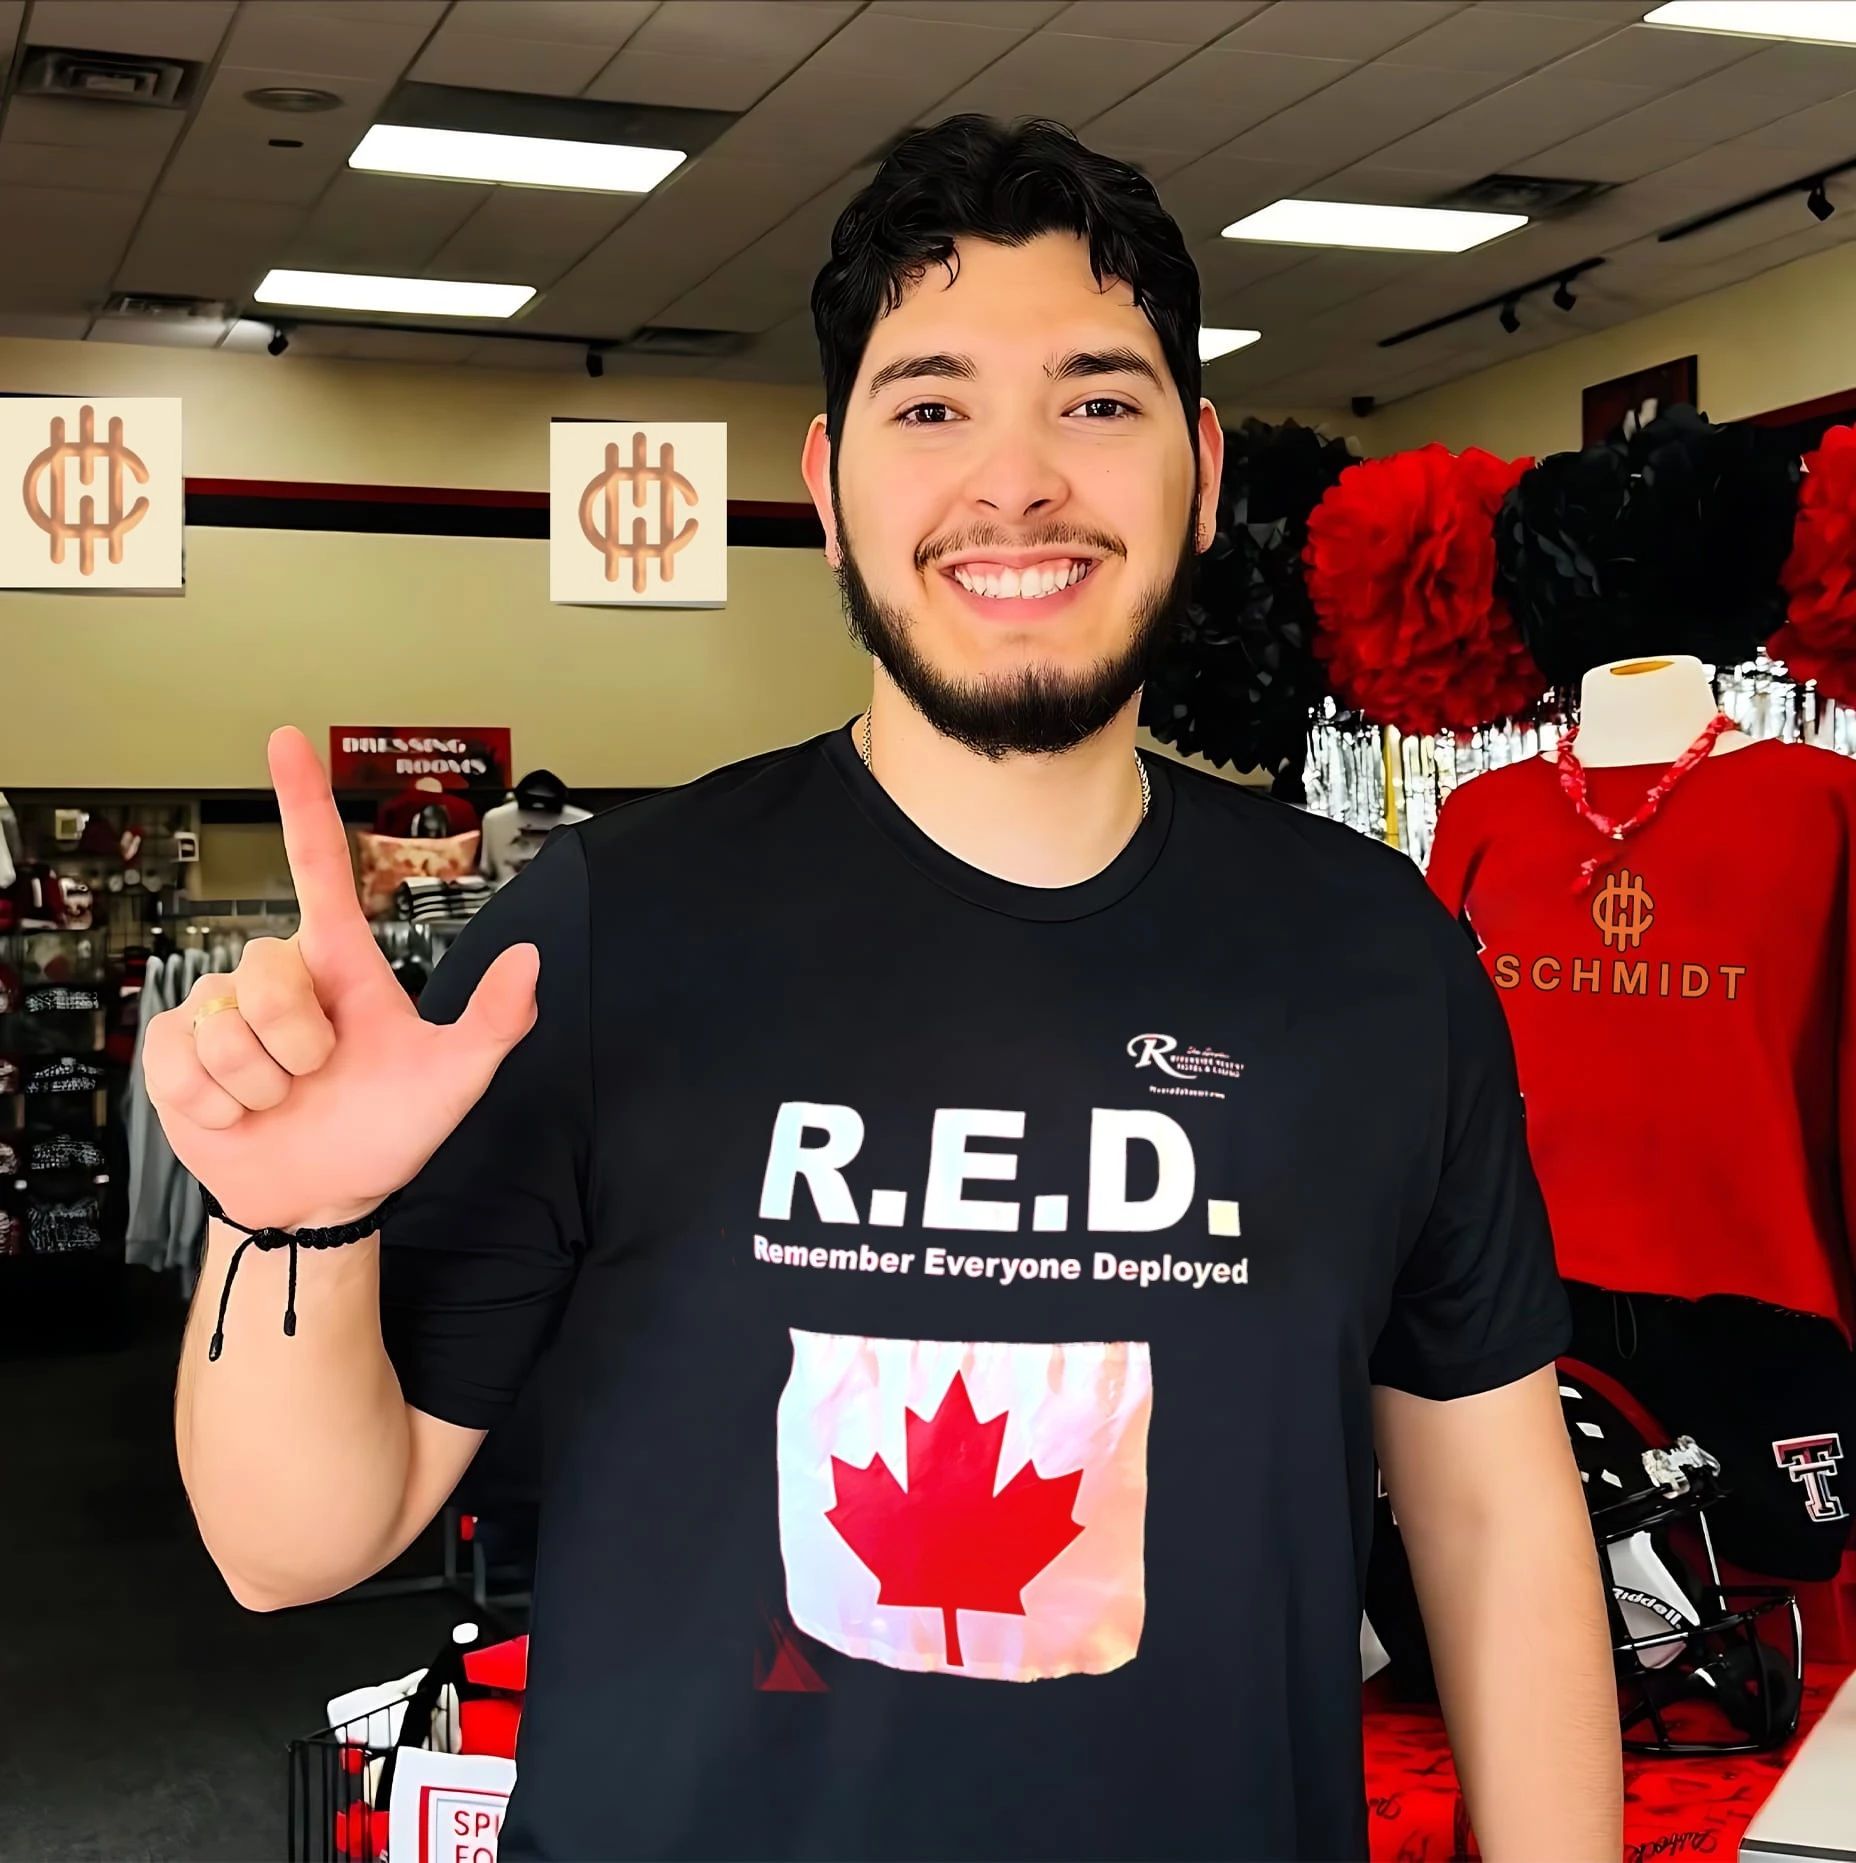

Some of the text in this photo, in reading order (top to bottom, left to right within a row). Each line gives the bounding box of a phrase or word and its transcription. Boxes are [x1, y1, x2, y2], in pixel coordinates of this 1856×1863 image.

[1493, 954, 1747, 1001] SCHMIDT
[1126, 1033, 1198, 1079] R
[759, 1101, 1241, 1237] R.E.D.
[753, 1234, 1249, 1289] Remember Everyone Deployed
